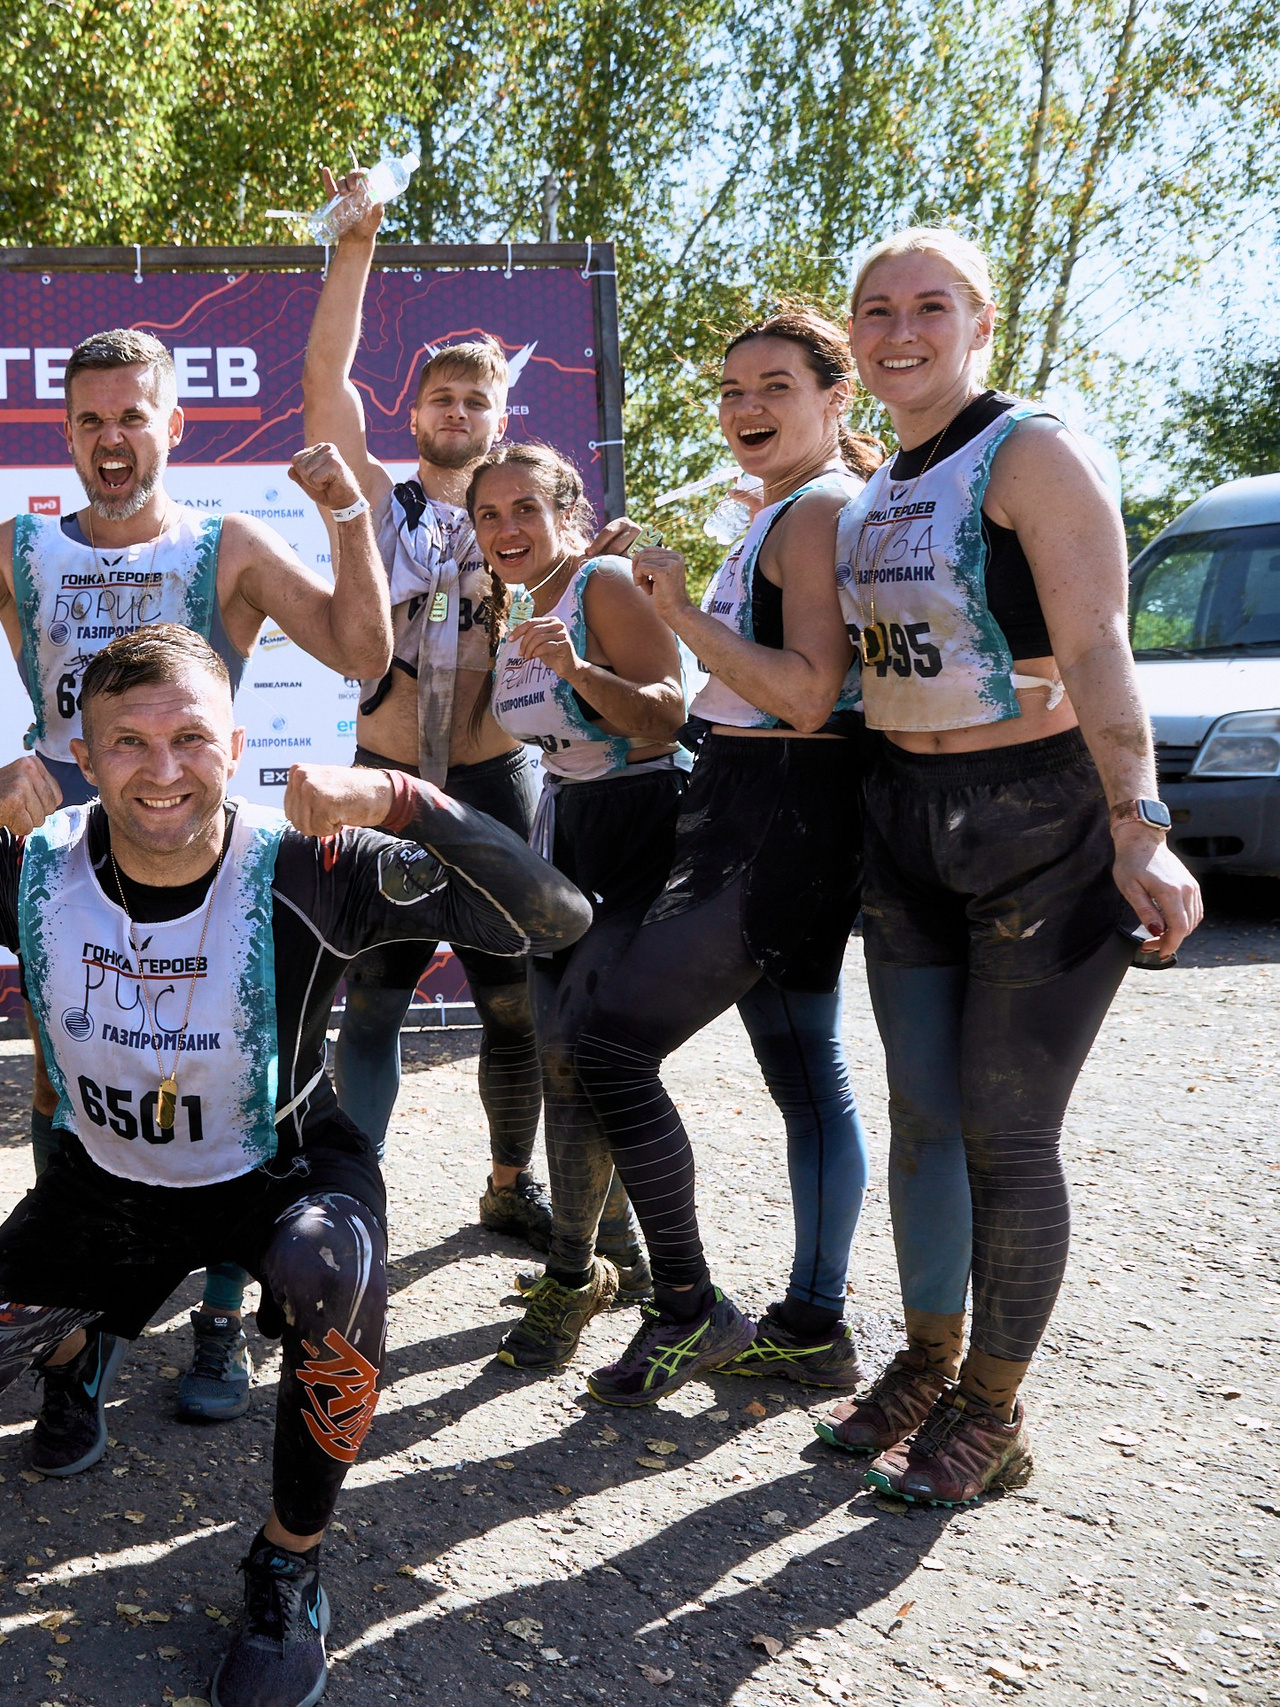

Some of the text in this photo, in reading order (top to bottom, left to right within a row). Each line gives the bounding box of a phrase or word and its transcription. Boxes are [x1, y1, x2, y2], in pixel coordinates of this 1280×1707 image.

[61, 571, 162, 585] ГОНКА ГЕРОЕВ
[51, 590, 161, 623] БОРИС
[247, 737, 312, 748] ГАЗПРОМБАНК
[82, 942, 208, 974] ГОНКА ГЕРОЕВ
[84, 958, 188, 1034] РУС
[102, 1023, 221, 1051] ГАЗПРОМБАНК
[77, 1074, 204, 1144] 6501
